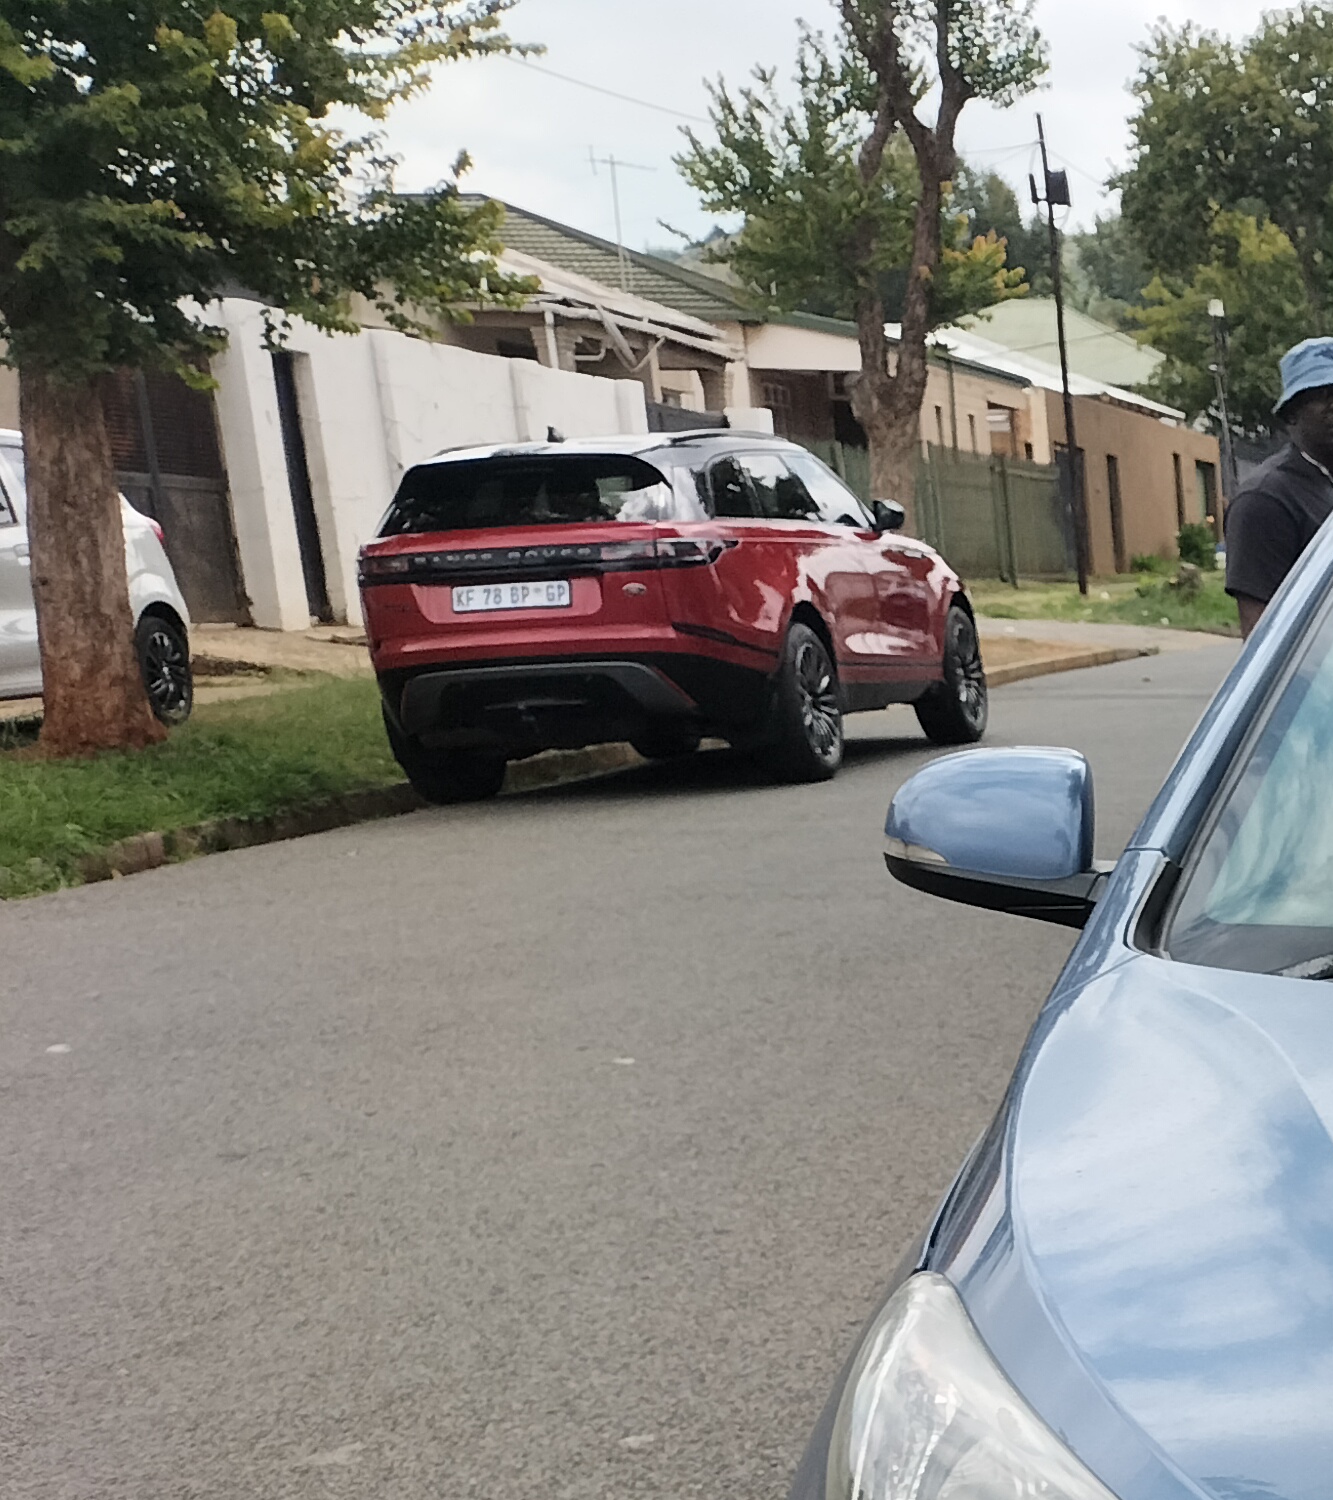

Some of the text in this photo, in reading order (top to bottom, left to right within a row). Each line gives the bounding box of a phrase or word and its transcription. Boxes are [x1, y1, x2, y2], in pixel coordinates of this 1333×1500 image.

[456, 588, 475, 607] KF
[482, 586, 501, 606] 78
[546, 583, 566, 602] GP
